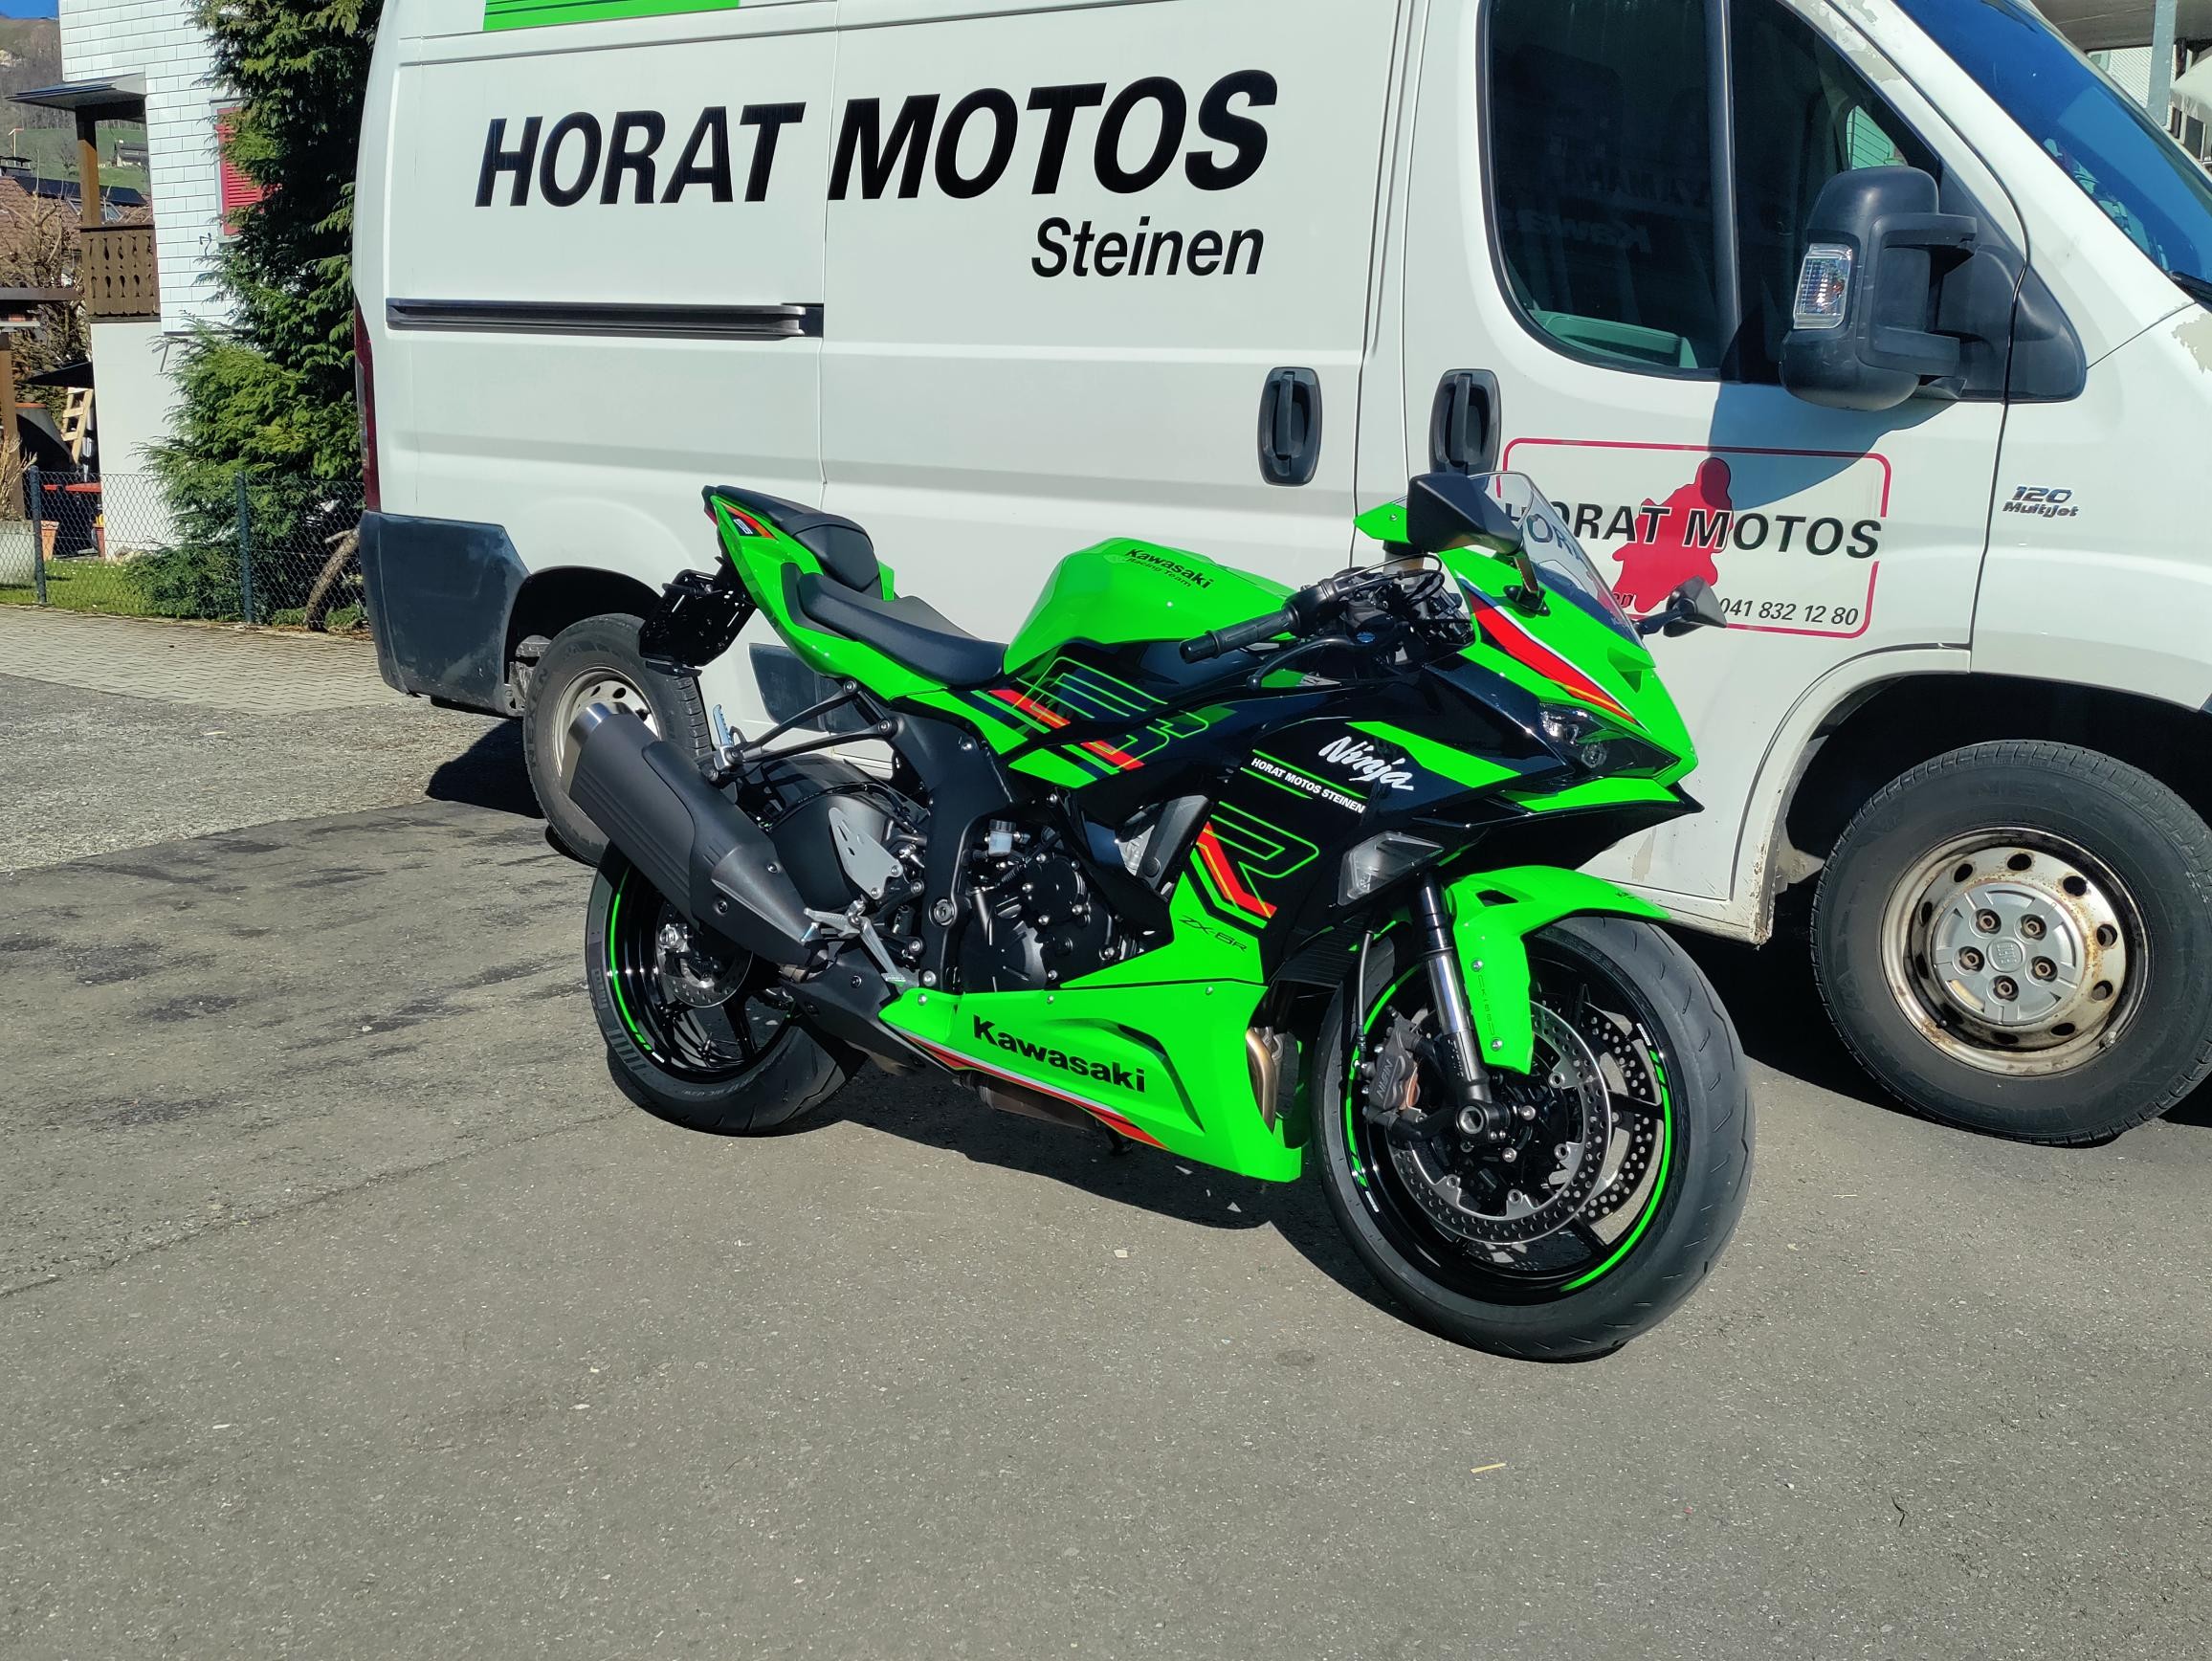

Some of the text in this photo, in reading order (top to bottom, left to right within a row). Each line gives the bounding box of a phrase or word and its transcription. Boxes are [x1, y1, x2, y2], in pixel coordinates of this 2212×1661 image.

[476, 70, 1277, 207] HORAT MOTOS
[1031, 216, 1263, 277] Steinen
[2011, 485, 2072, 503] 120
[1684, 510, 1881, 559] MOTOS
[1125, 548, 1214, 588] Kawasaki
[1126, 558, 1191, 587] Racing Team
[1719, 597, 1859, 626] 041 832 12 80
[1250, 757, 1366, 814] HORAT MOTOS STEINEN
[1317, 736, 1414, 791] Ninja
[1178, 914, 1248, 952] ZX-6R
[972, 1014, 1146, 1093] Kawasaki
